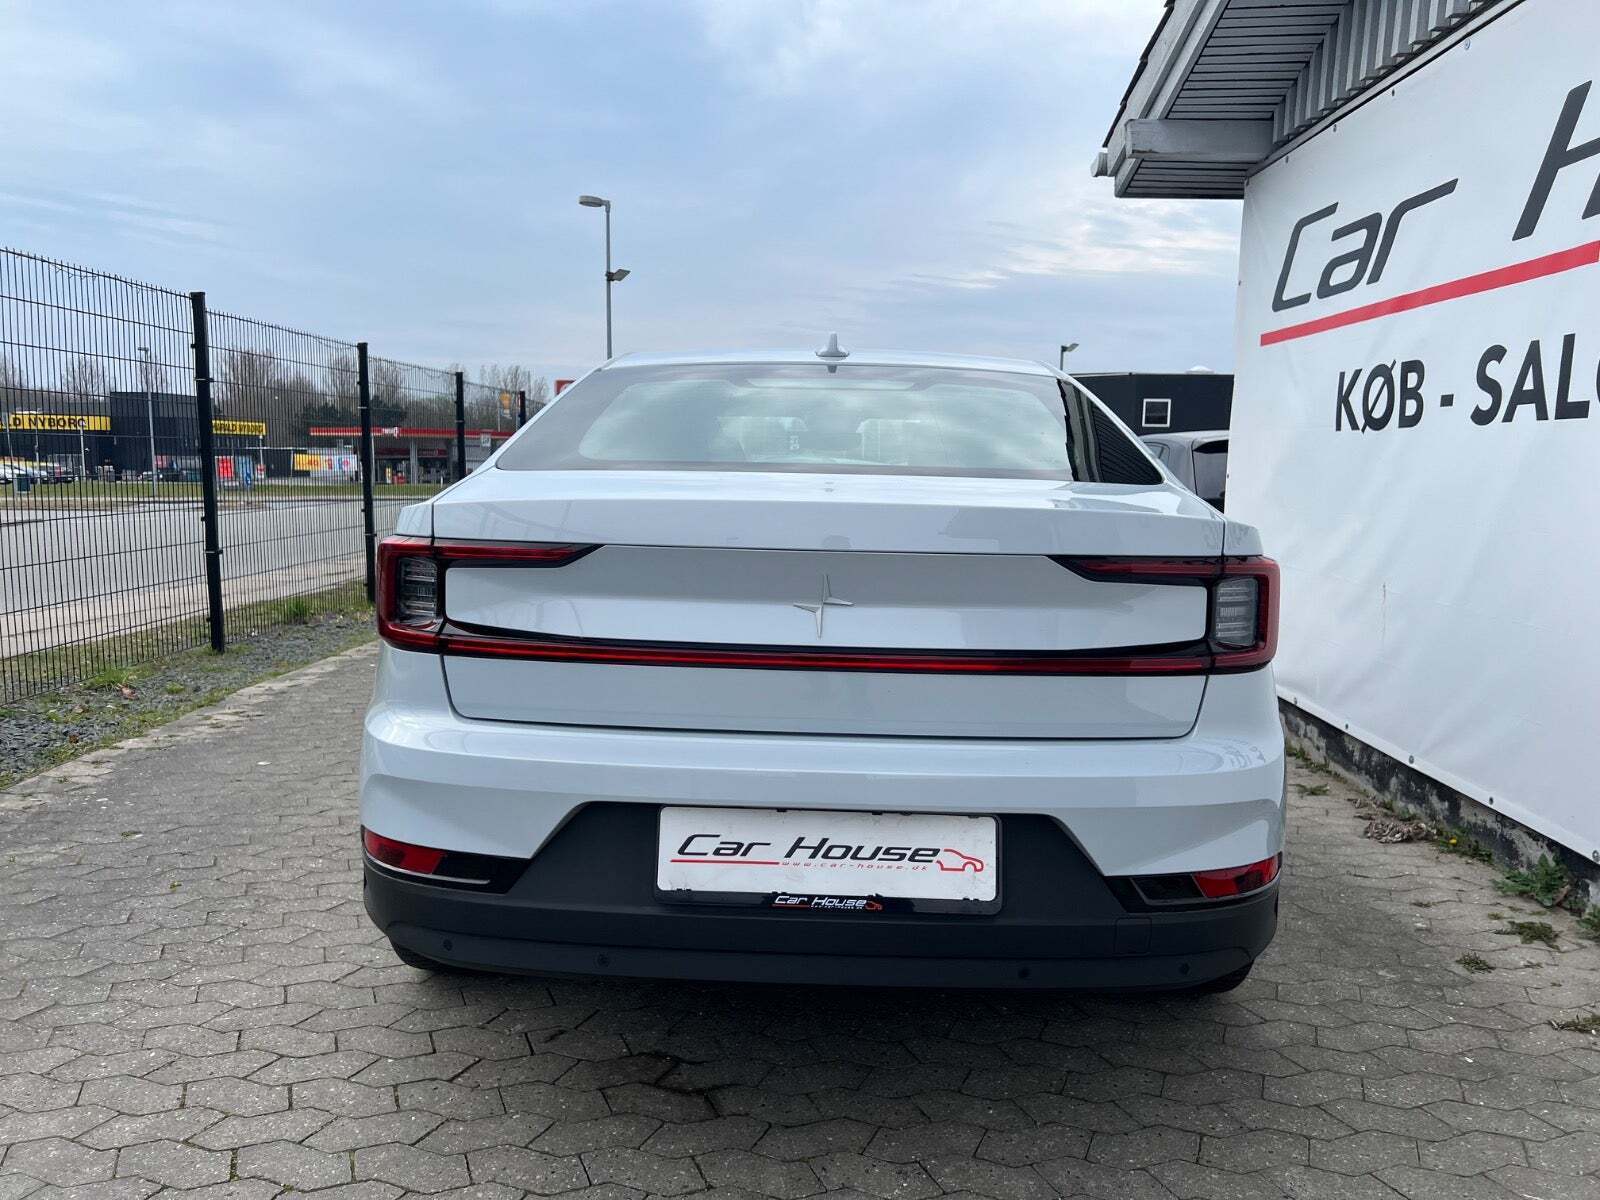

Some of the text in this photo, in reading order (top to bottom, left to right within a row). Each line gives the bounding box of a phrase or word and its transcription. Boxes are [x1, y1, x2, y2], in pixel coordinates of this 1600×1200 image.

[1272, 177, 1459, 312] Car
[1335, 359, 1426, 433] KØB
[1471, 333, 1600, 426] SAL
[677, 834, 941, 863] Car House
[774, 895, 808, 905] Car
[812, 896, 867, 907] House
